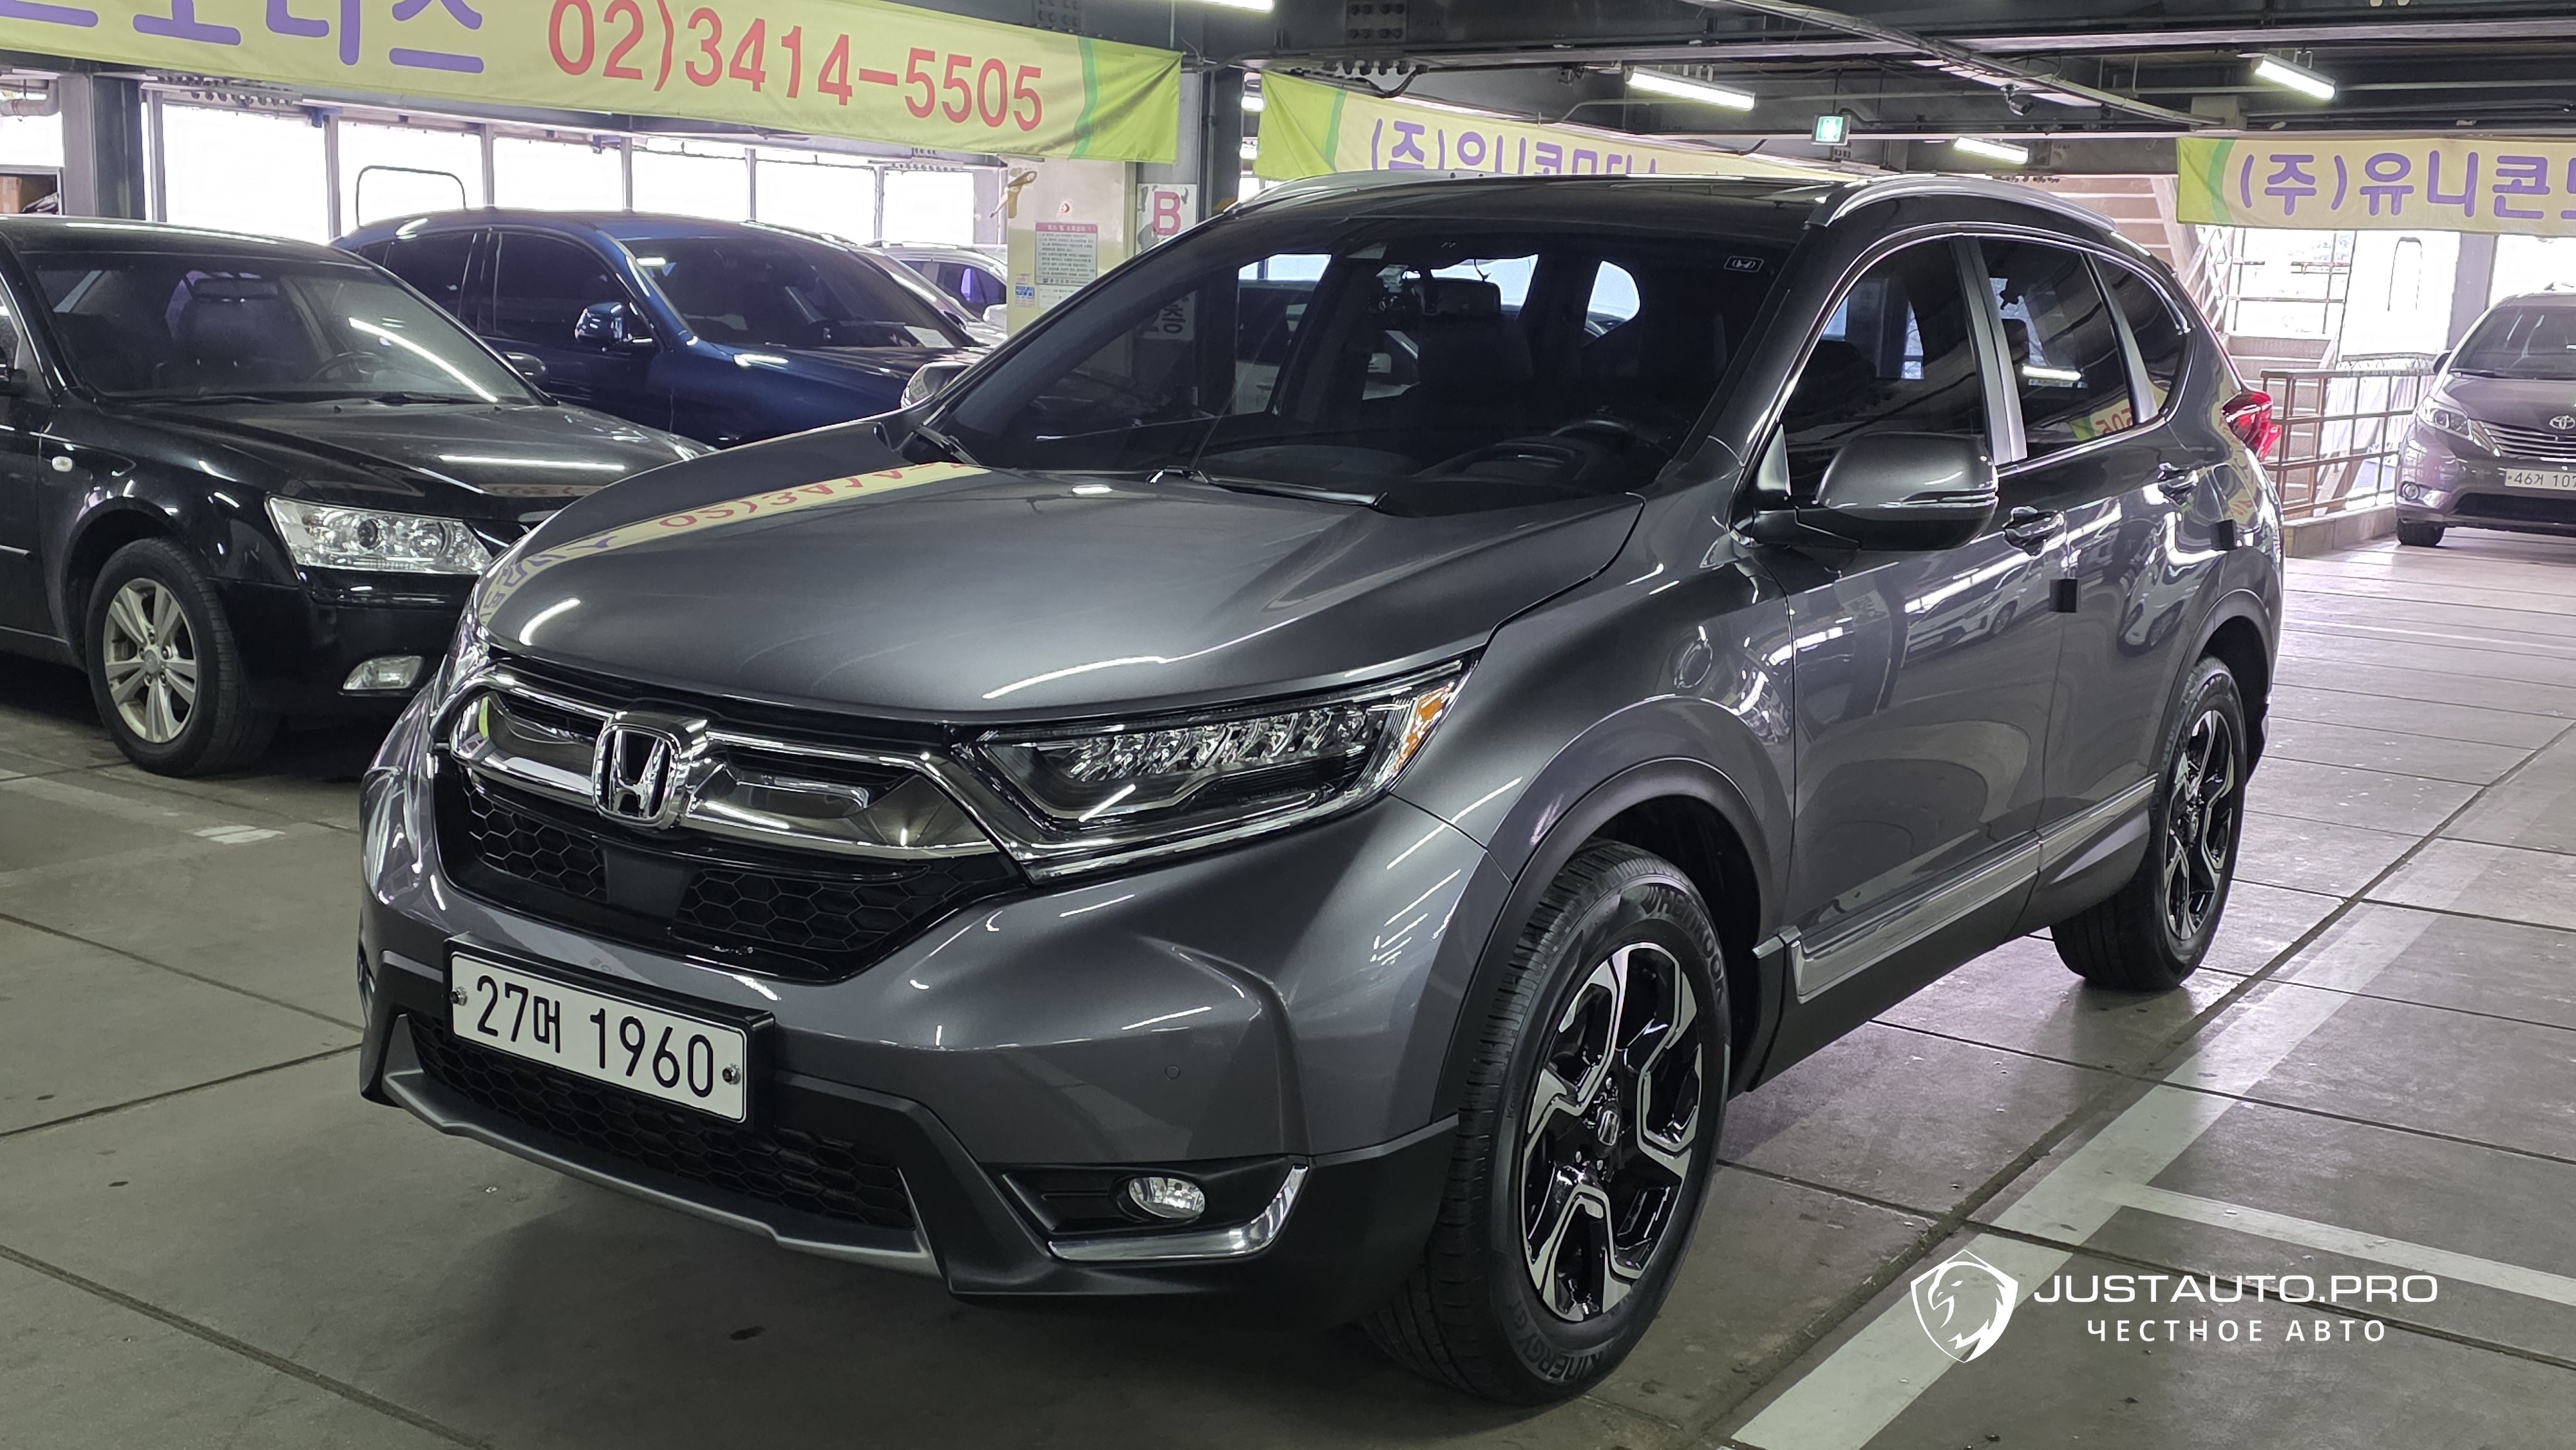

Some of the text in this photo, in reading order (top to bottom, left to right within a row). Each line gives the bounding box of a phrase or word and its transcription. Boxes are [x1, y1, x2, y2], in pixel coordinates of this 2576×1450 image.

[549, 0, 1042, 131] 02)3414-5505
[1153, 191, 1181, 235] B
[2239, 149, 2576, 220] (주)유니콘
[2514, 472, 2544, 485] 46거
[476, 974, 714, 1098] 27머 1960
